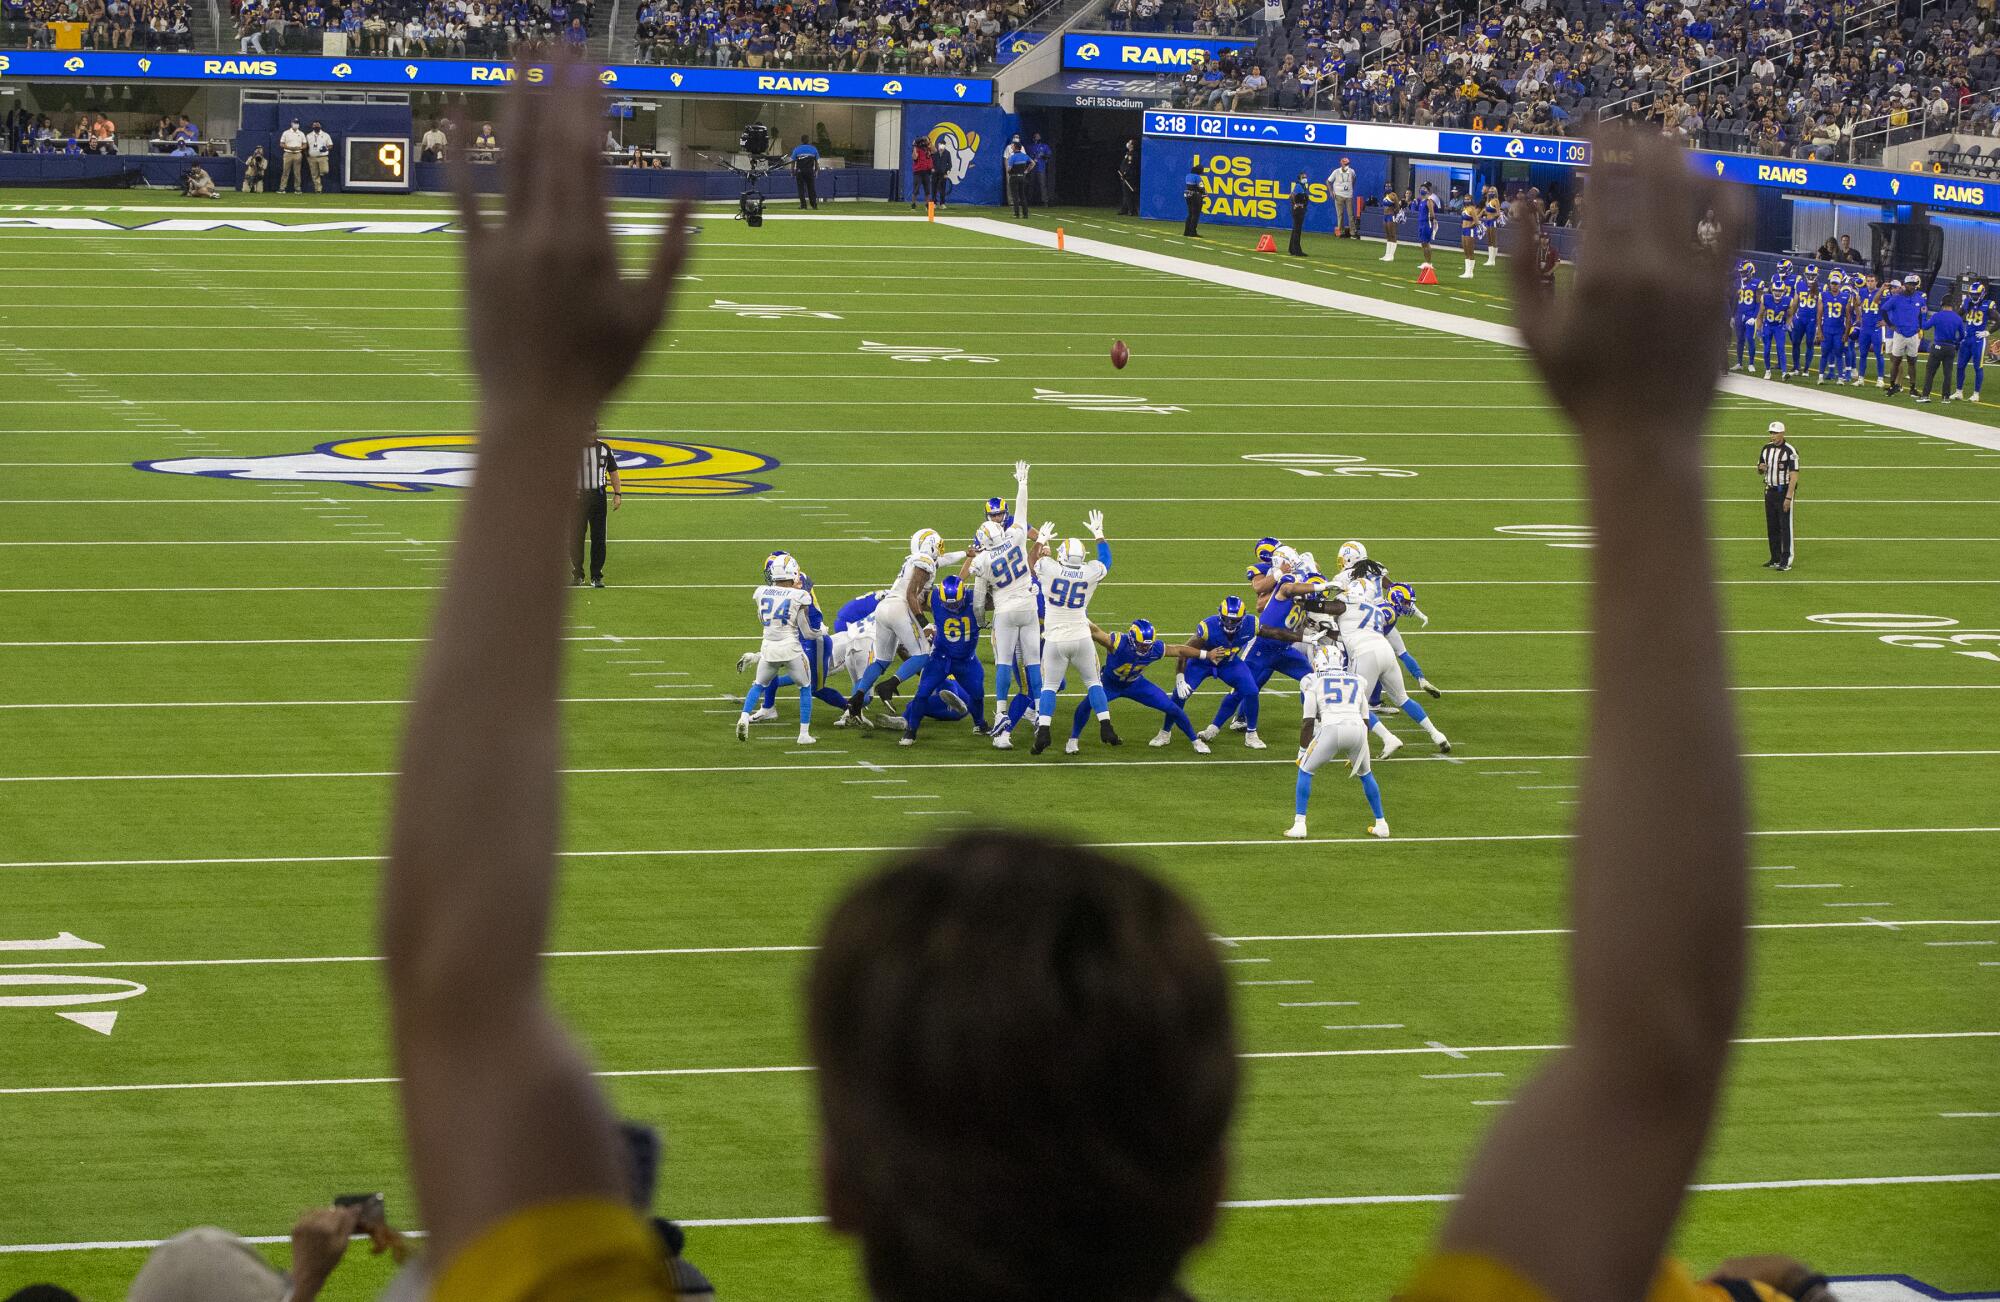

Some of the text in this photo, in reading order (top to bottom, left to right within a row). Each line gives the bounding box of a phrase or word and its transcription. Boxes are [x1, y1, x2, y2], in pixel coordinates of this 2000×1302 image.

[1122, 46, 1205, 66] RAMS
[204, 61, 277, 76] RAMS
[758, 76, 829, 92] RAMS
[1075, 96, 1143, 109] SoFi Stadium
[1154, 115, 1316, 142] 3:18 Q2 3
[1470, 136, 1482, 154] 6
[379, 143, 401, 177] 9
[1193, 154, 1252, 176] LOS
[1758, 165, 1807, 185] RAMS
[1934, 184, 1984, 205] RAMS
[1827, 301, 1842, 318] 13
[990, 545, 1028, 589] 92
[1048, 578, 1089, 609] 96
[760, 597, 791, 627] 24
[944, 616, 971, 643] 61
[1323, 677, 1359, 704] 57
